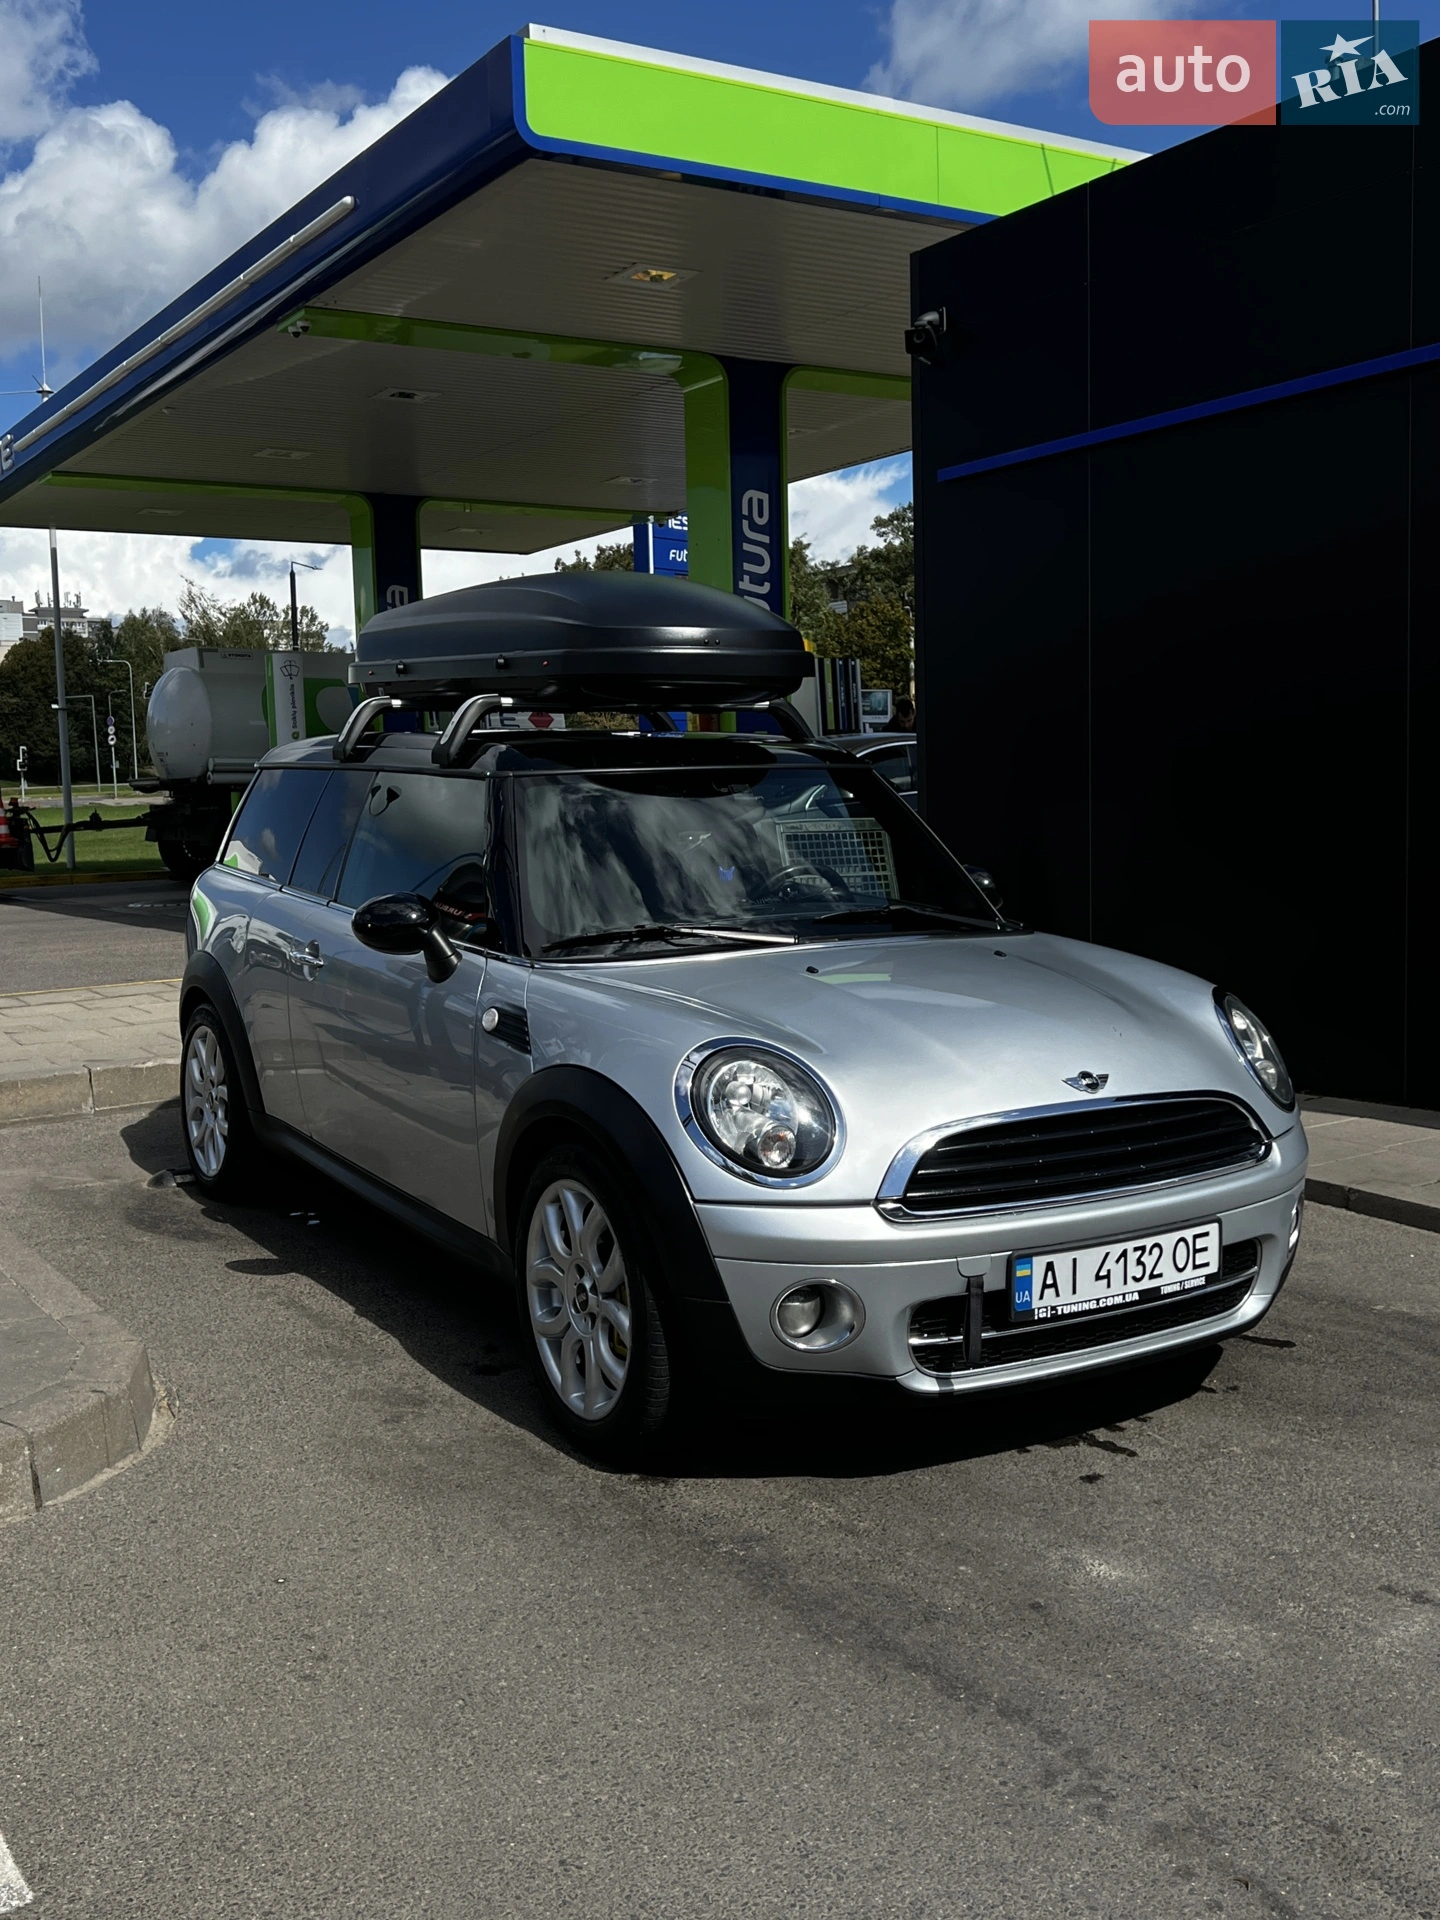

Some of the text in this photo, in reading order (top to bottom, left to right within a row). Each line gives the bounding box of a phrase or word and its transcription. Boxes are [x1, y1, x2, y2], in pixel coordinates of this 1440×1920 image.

[1038, 1231, 1210, 1301] AI 4132 OE
[1015, 1290, 1031, 1303] UA
